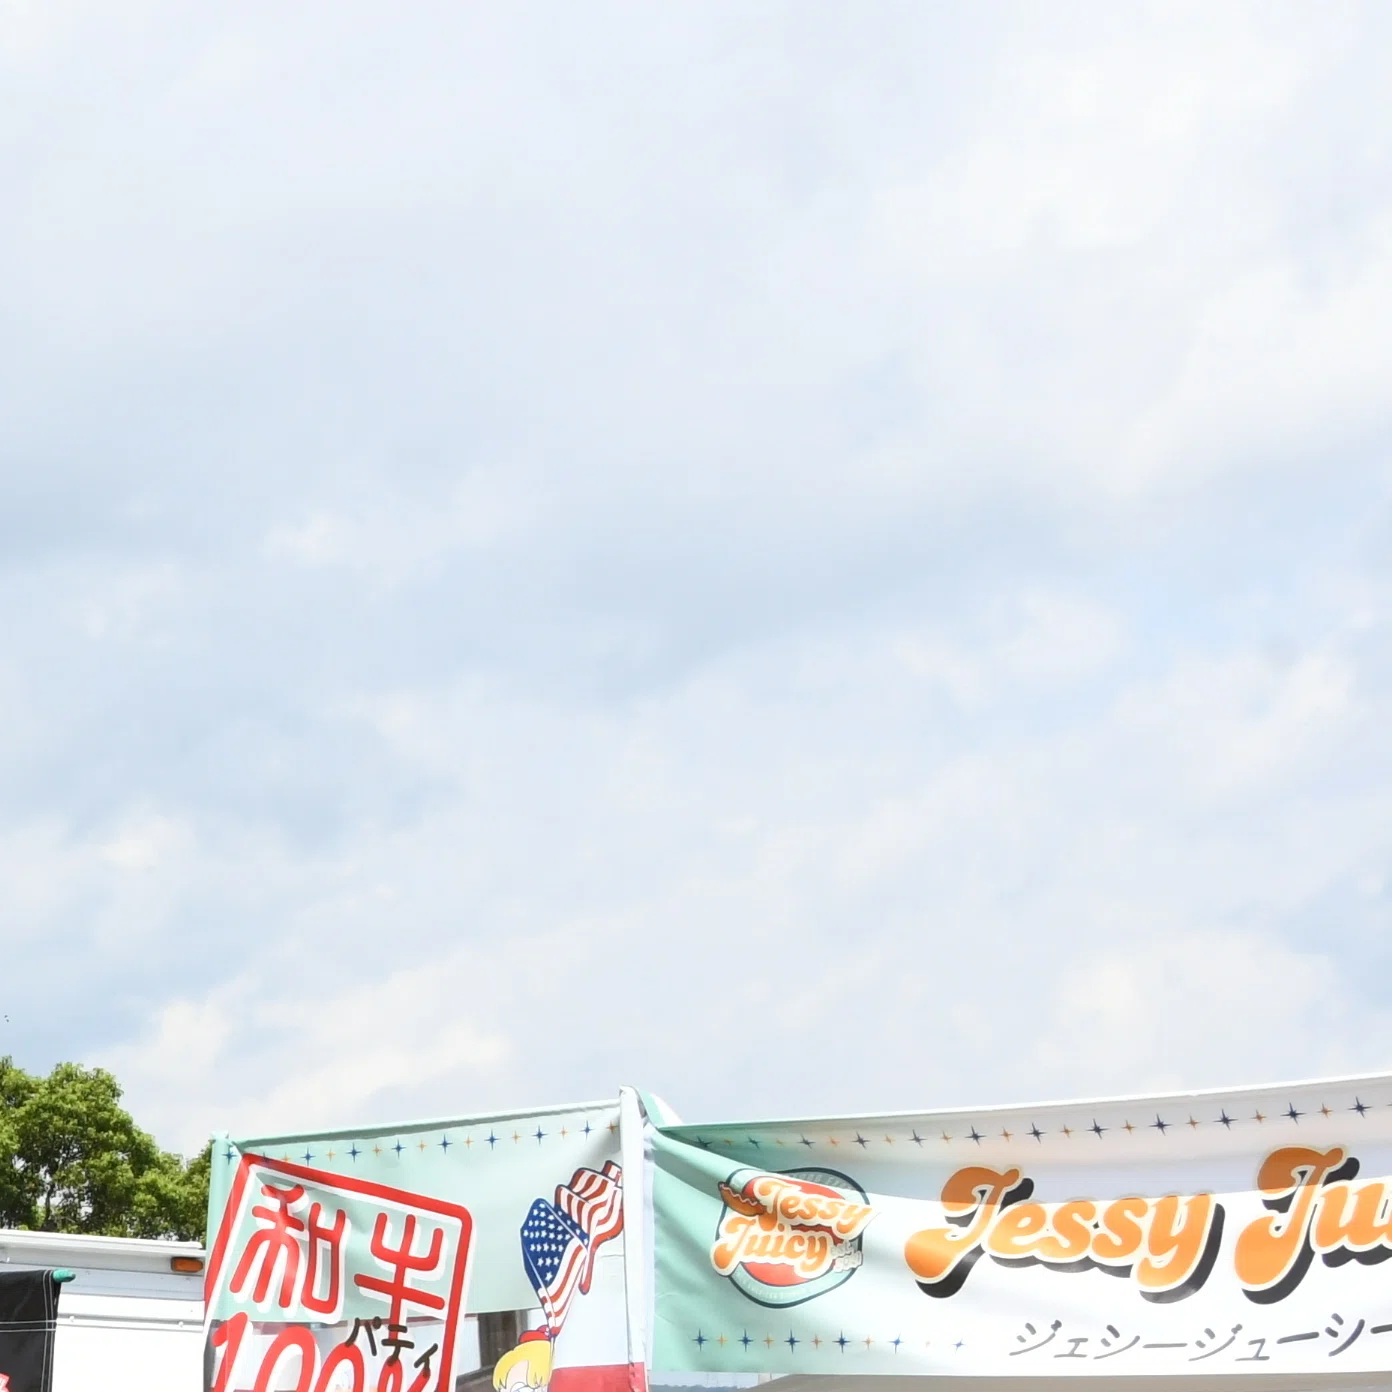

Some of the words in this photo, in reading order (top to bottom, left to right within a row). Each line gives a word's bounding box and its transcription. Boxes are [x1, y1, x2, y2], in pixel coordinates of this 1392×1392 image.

[757, 1180, 873, 1235] Jessy
[904, 1166, 1224, 1303] Jessy
[230, 1184, 445, 1328] 和牛
[713, 1216, 828, 1273] Juicy
[347, 1315, 439, 1371] パティ
